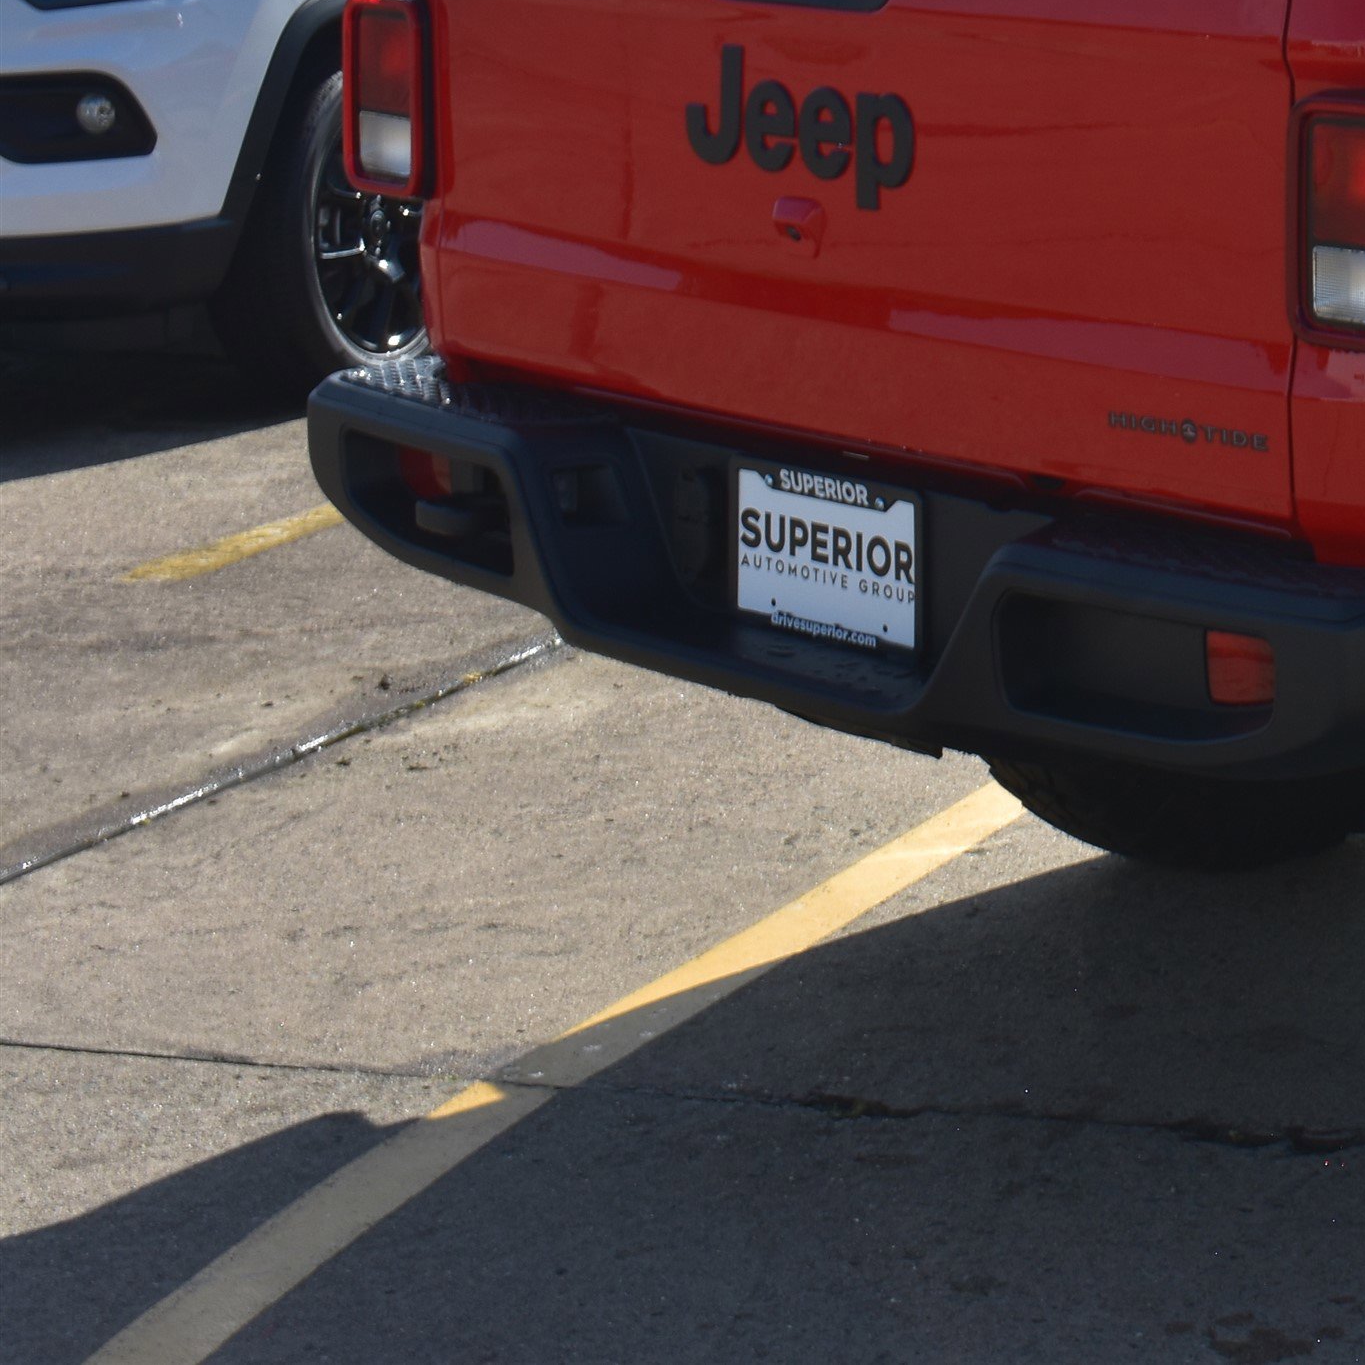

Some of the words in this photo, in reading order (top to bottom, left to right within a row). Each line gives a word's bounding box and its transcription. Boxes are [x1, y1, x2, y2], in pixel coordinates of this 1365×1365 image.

[685, 43, 915, 211] Jeep
[1108, 411, 1178, 436] HIGH
[1201, 424, 1270, 452] TIDE
[779, 468, 869, 507] SUPERIOR
[740, 507, 915, 585] SUPERIOR
[740, 553, 849, 589] AUTOMOTIVE
[859, 578, 915, 604] GROUP
[770, 611, 877, 648] drivesuperior.com
